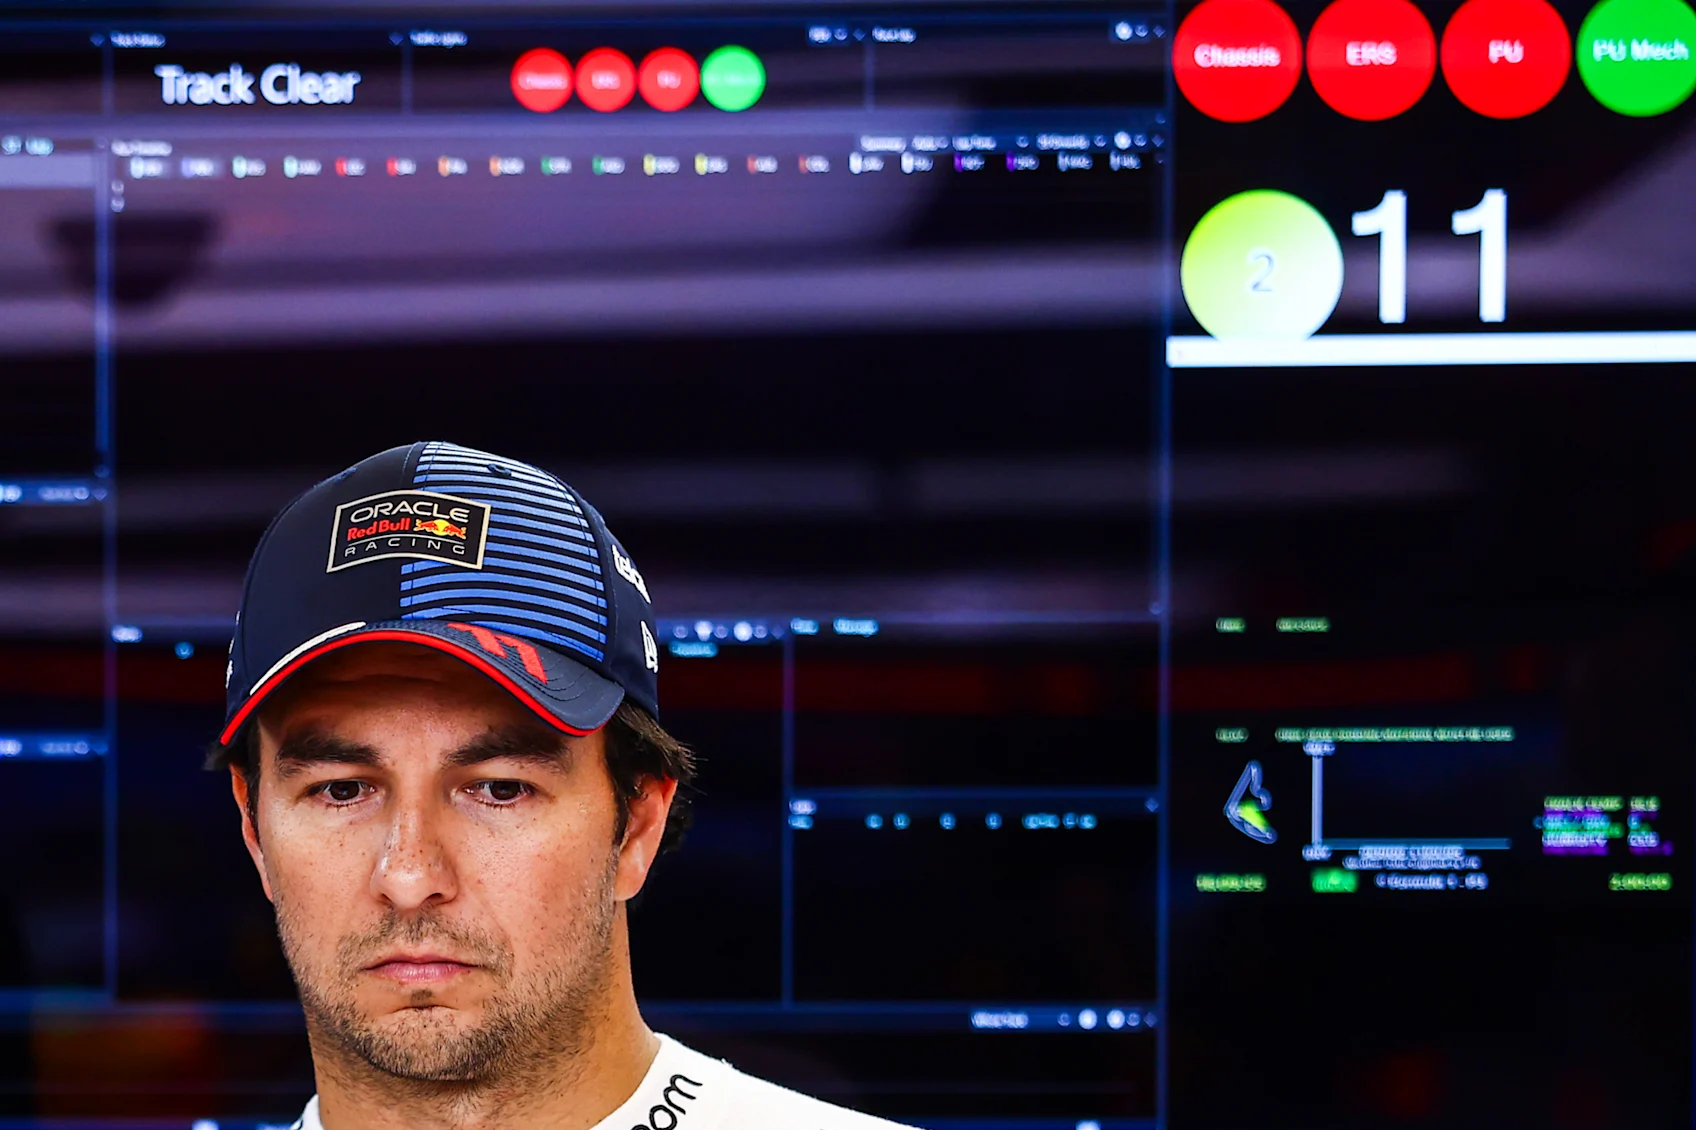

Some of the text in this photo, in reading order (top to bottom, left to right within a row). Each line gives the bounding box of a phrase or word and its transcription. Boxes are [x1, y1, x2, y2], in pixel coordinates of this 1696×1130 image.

[1194, 43, 1281, 68] Chassis
[1345, 41, 1397, 65] ERS
[1489, 41, 1524, 64] PU
[1593, 39, 1689, 62] PU Mech
[154, 62, 361, 104] Track Clear
[1246, 247, 1275, 292] 2
[350, 501, 470, 523] ORACLE
[344, 538, 465, 557] RACING
